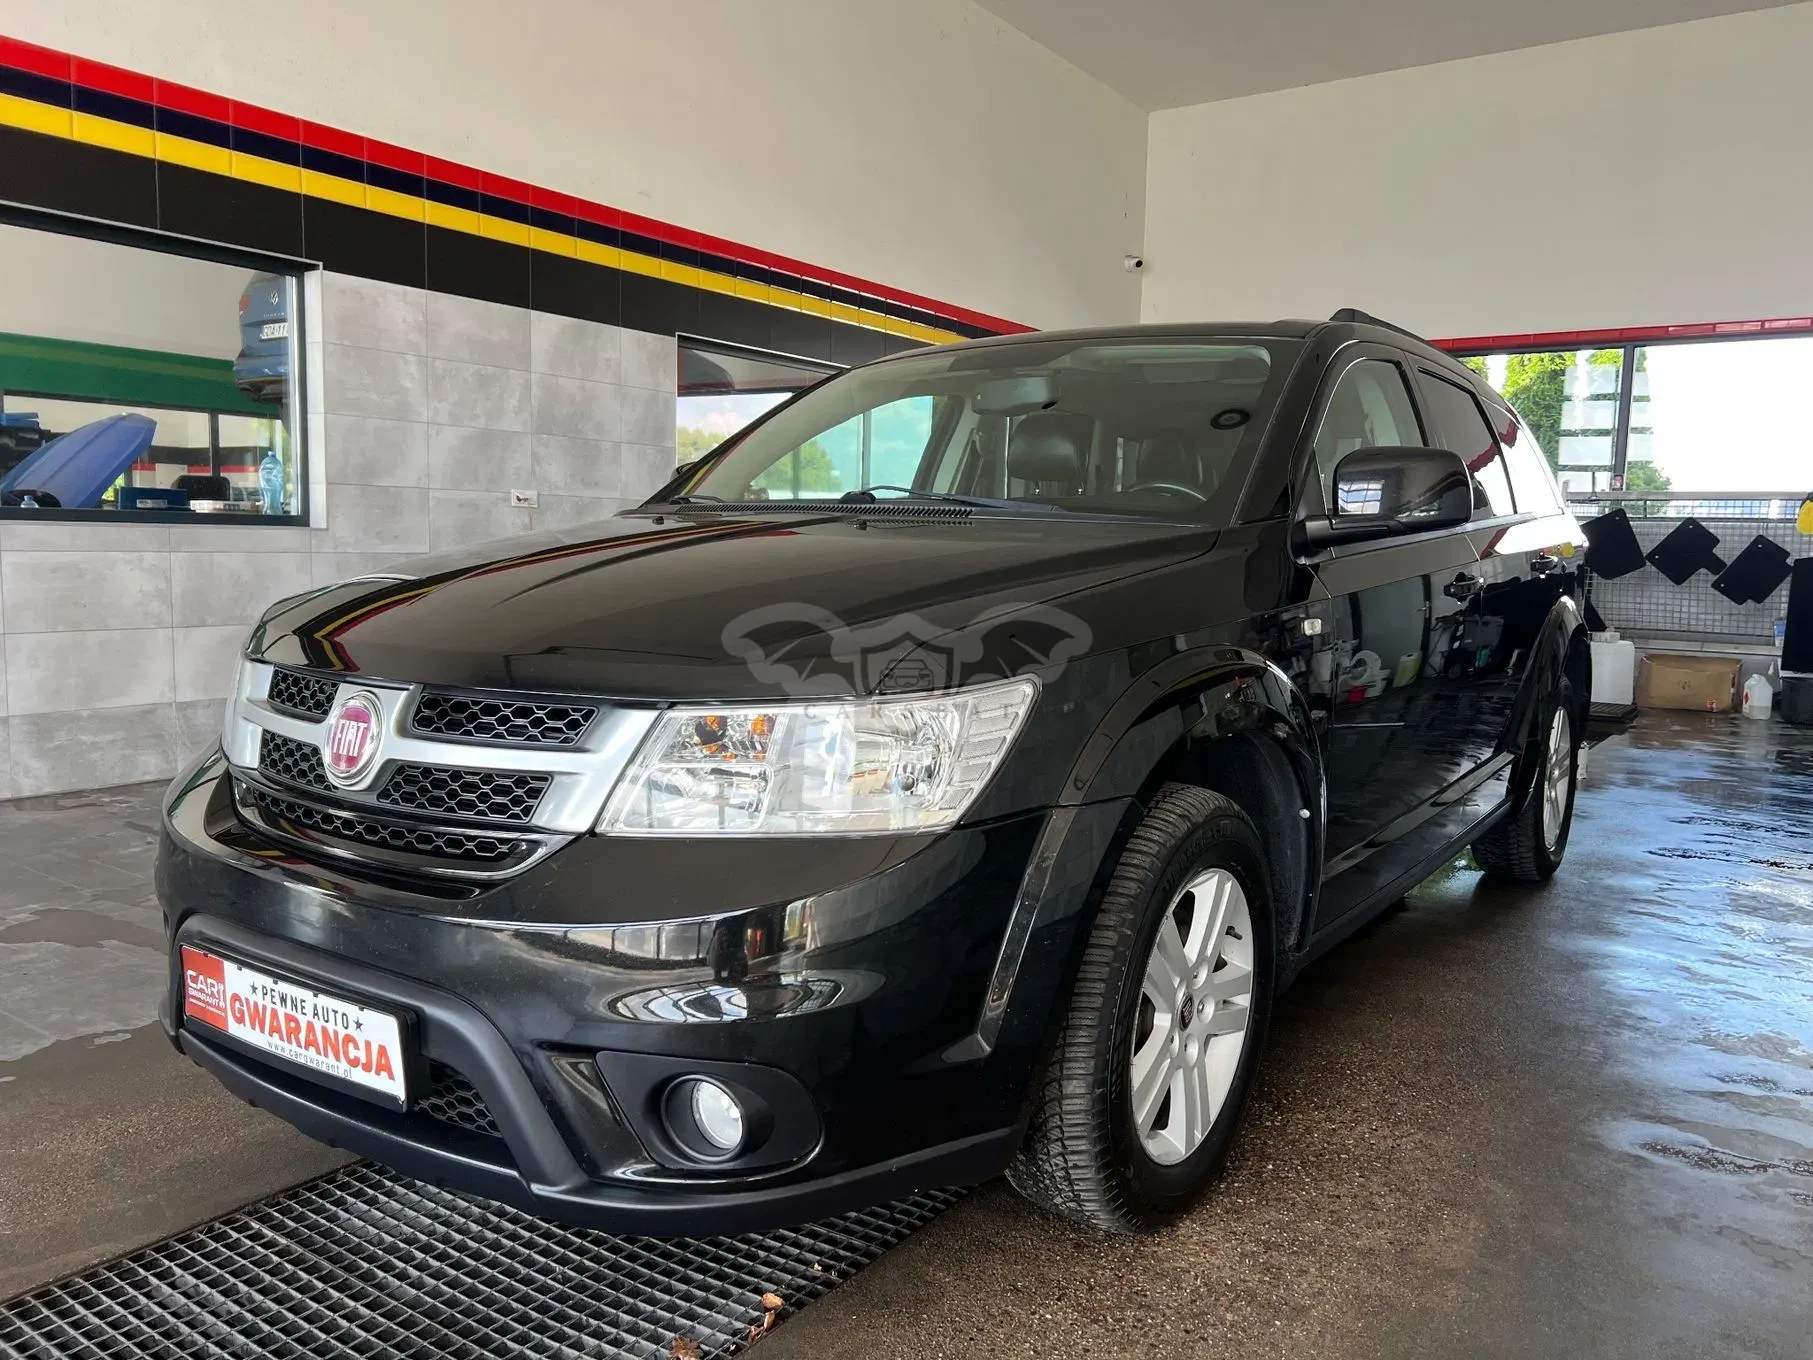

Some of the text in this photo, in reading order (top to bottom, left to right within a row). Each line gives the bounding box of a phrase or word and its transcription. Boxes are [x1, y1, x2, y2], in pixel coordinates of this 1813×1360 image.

[333, 719, 368, 758] FIAT
[262, 985, 349, 1030] PEWNE AUTO
[229, 992, 395, 1081] GWARANCJA
[267, 1040, 352, 1079] www.cargwarant.pl
